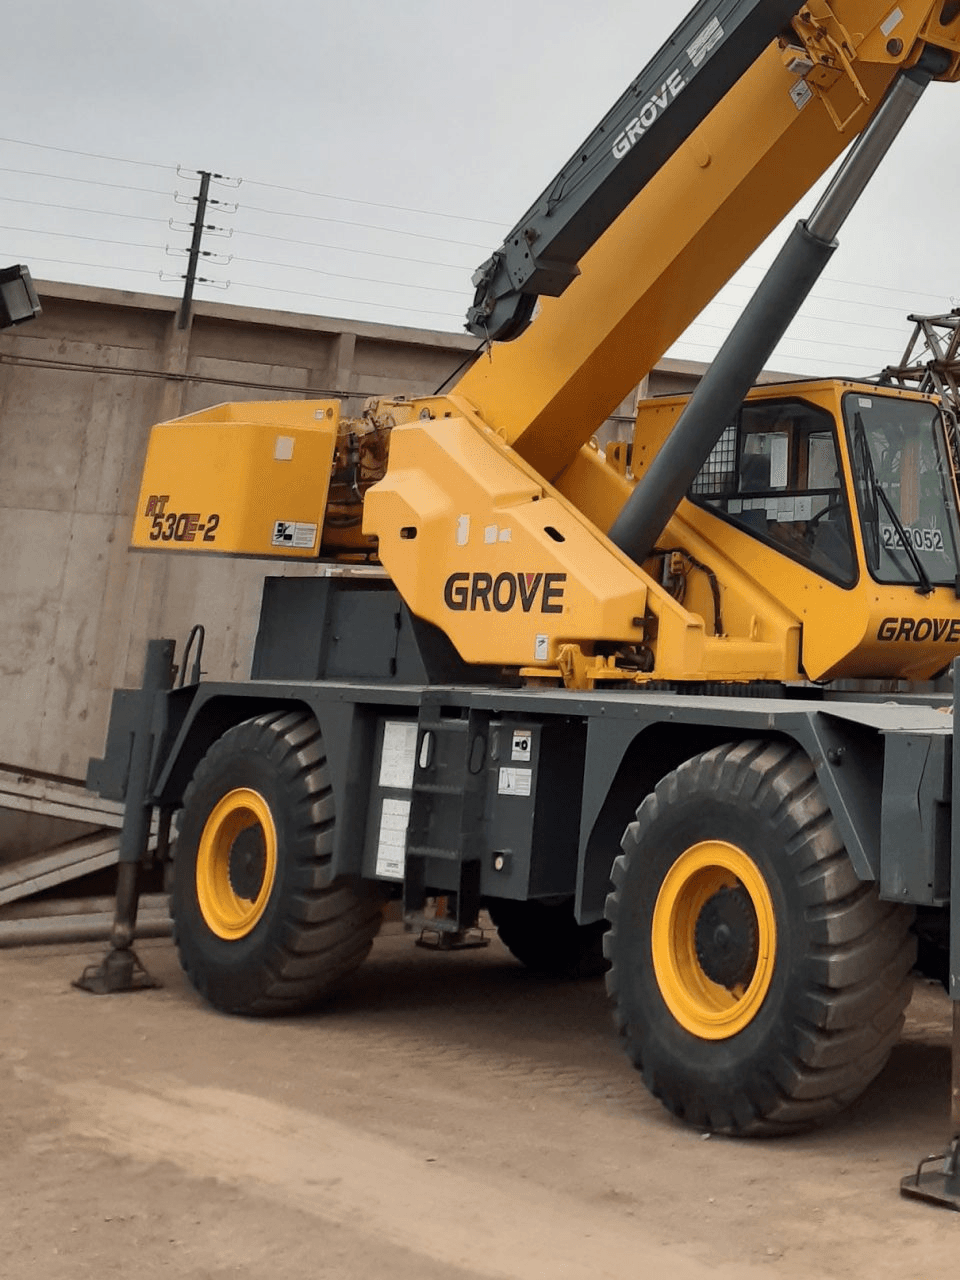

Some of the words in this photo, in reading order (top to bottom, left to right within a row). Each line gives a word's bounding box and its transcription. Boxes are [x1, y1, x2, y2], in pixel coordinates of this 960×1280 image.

[611, 68, 686, 160] GROVE
[145, 495, 170, 517] RT
[149, 513, 220, 542] 530E-2
[443, 571, 568, 614] GROVE
